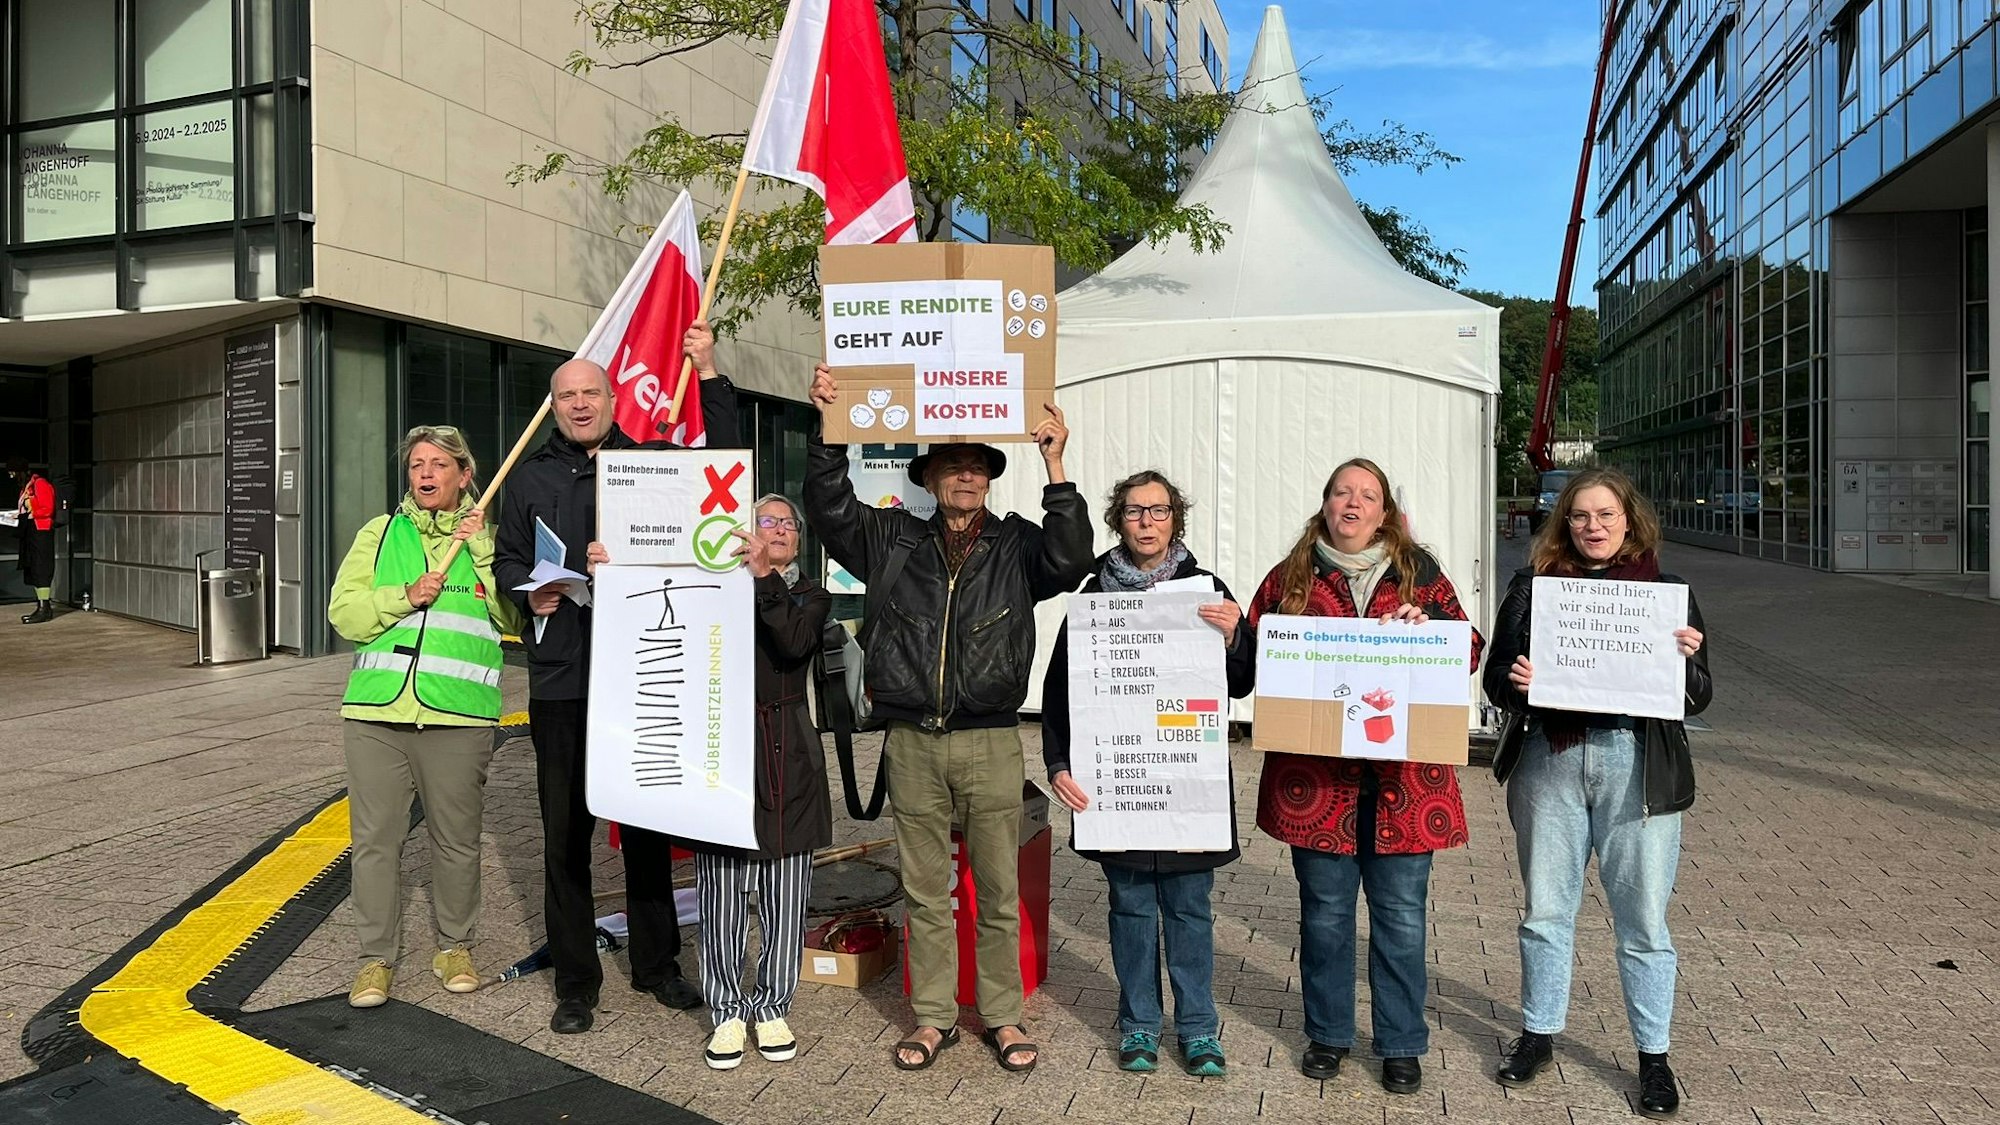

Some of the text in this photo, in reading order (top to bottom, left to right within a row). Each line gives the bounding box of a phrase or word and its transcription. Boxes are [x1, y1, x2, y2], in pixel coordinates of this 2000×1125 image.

[184, 119, 227, 136] 2.2.2025
[833, 298, 993, 317] EURE RENDITE
[834, 331, 944, 349] GEHT AUF
[923, 371, 1008, 386] UNSERE
[923, 404, 1008, 420] KOSTEN
[607, 464, 679, 475] Bei Urheber:innen
[1843, 465, 1858, 475] 6A
[607, 478, 635, 487] sparen
[630, 524, 682, 534] Hoch mit den
[630, 537, 675, 546] Honoraren!
[1561, 581, 1656, 600] Wir sind hier,
[1090, 601, 1096, 611] B
[1109, 599, 1143, 610] BÜCHER
[1559, 601, 1650, 618] wir sind laut,
[1091, 618, 1097, 628] A
[1108, 618, 1125, 628] AUS
[1558, 618, 1640, 634] weil ihr uns
[1092, 635, 1097, 645] S
[1109, 633, 1164, 645] SCHLECHTEN
[1267, 629, 1299, 641] Mein
[1557, 635, 1653, 654] TANTIEMEN
[1093, 651, 1097, 661] T
[1109, 650, 1140, 660] TEXTEN
[1266, 649, 1463, 667] Faire Übersetzungshonorare
[1556, 654, 1596, 669] klaut!
[1094, 669, 1099, 678] E
[1111, 667, 1159, 678] ERZEUGEN,
[1095, 686, 1098, 696] I
[1110, 685, 1121, 696] IM
[1124, 684, 1155, 695] ERNST?
[1156, 699, 1184, 712] BAS
[1199, 714, 1219, 727] TEI
[1095, 736, 1100, 746] L
[1112, 735, 1141, 745] LIEBER
[1157, 729, 1201, 742] LÜBBE
[1096, 752, 1102, 763] Ü
[1114, 752, 1198, 764] ÜBERSETZER:INNEN
[1096, 769, 1102, 779] B
[1114, 768, 1147, 779] BESSER
[1097, 786, 1103, 795] B
[1115, 785, 1163, 795] BETEILIGEN
[1166, 785, 1172, 795] &
[1098, 802, 1103, 811] E
[1115, 801, 1168, 811] ENTLOHNEN!
